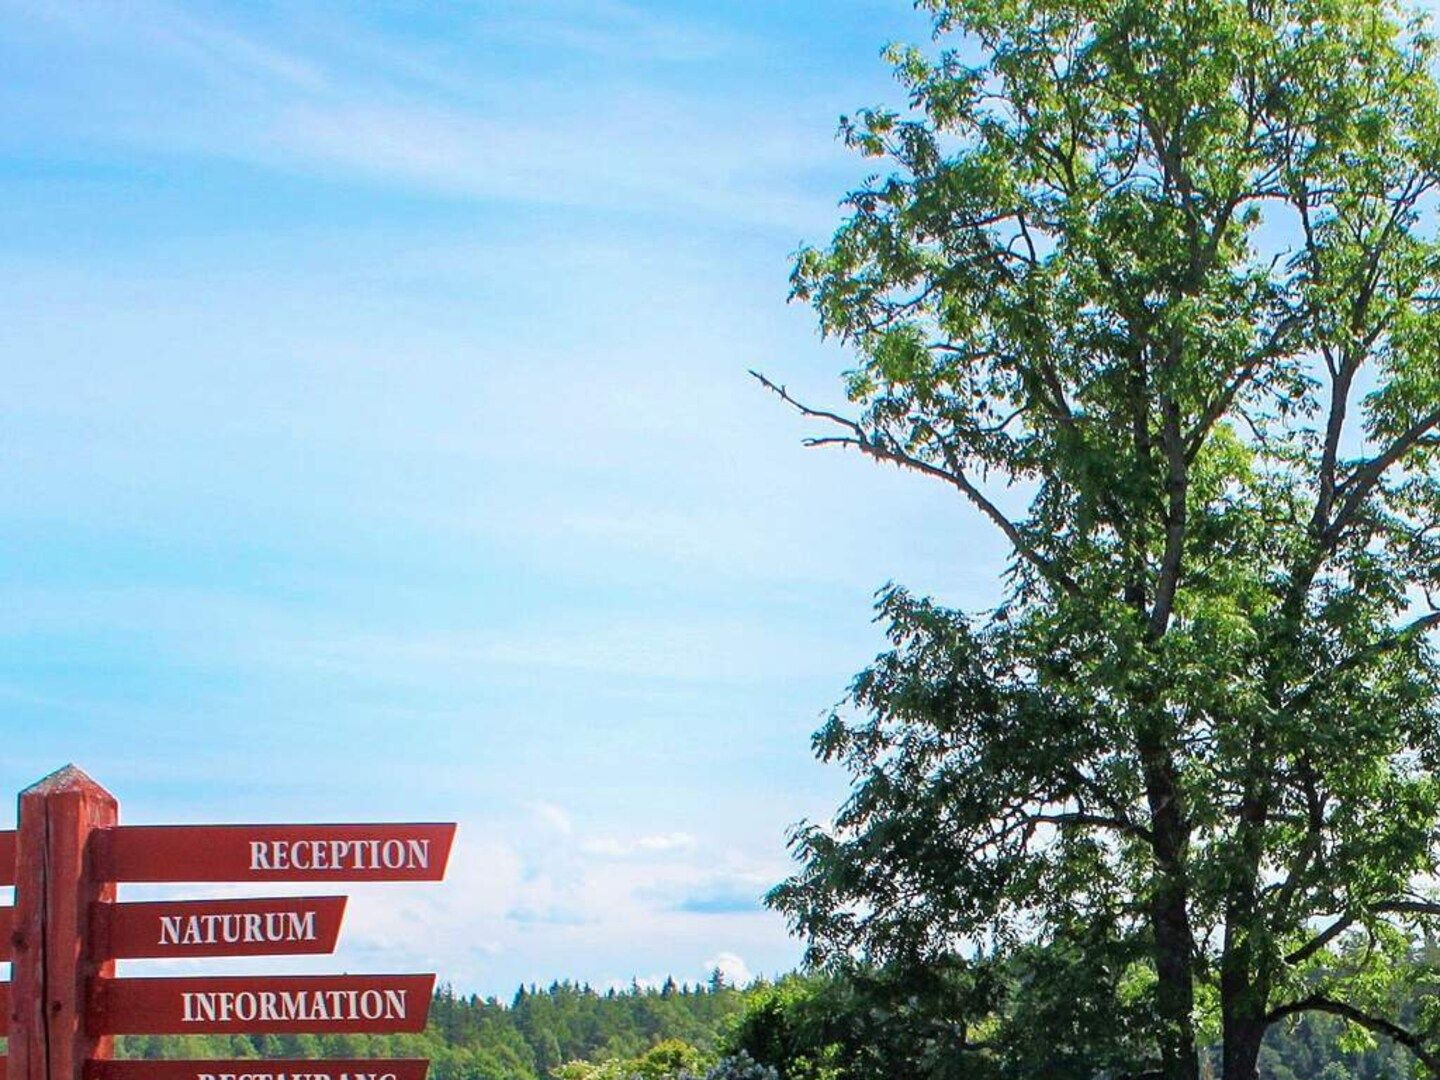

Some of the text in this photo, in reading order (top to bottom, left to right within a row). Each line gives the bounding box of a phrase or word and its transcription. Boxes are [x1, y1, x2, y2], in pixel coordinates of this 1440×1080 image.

[248, 839, 430, 871] RECEPTION
[157, 911, 317, 946] NATURUM
[180, 989, 407, 1022] INFORMATION
